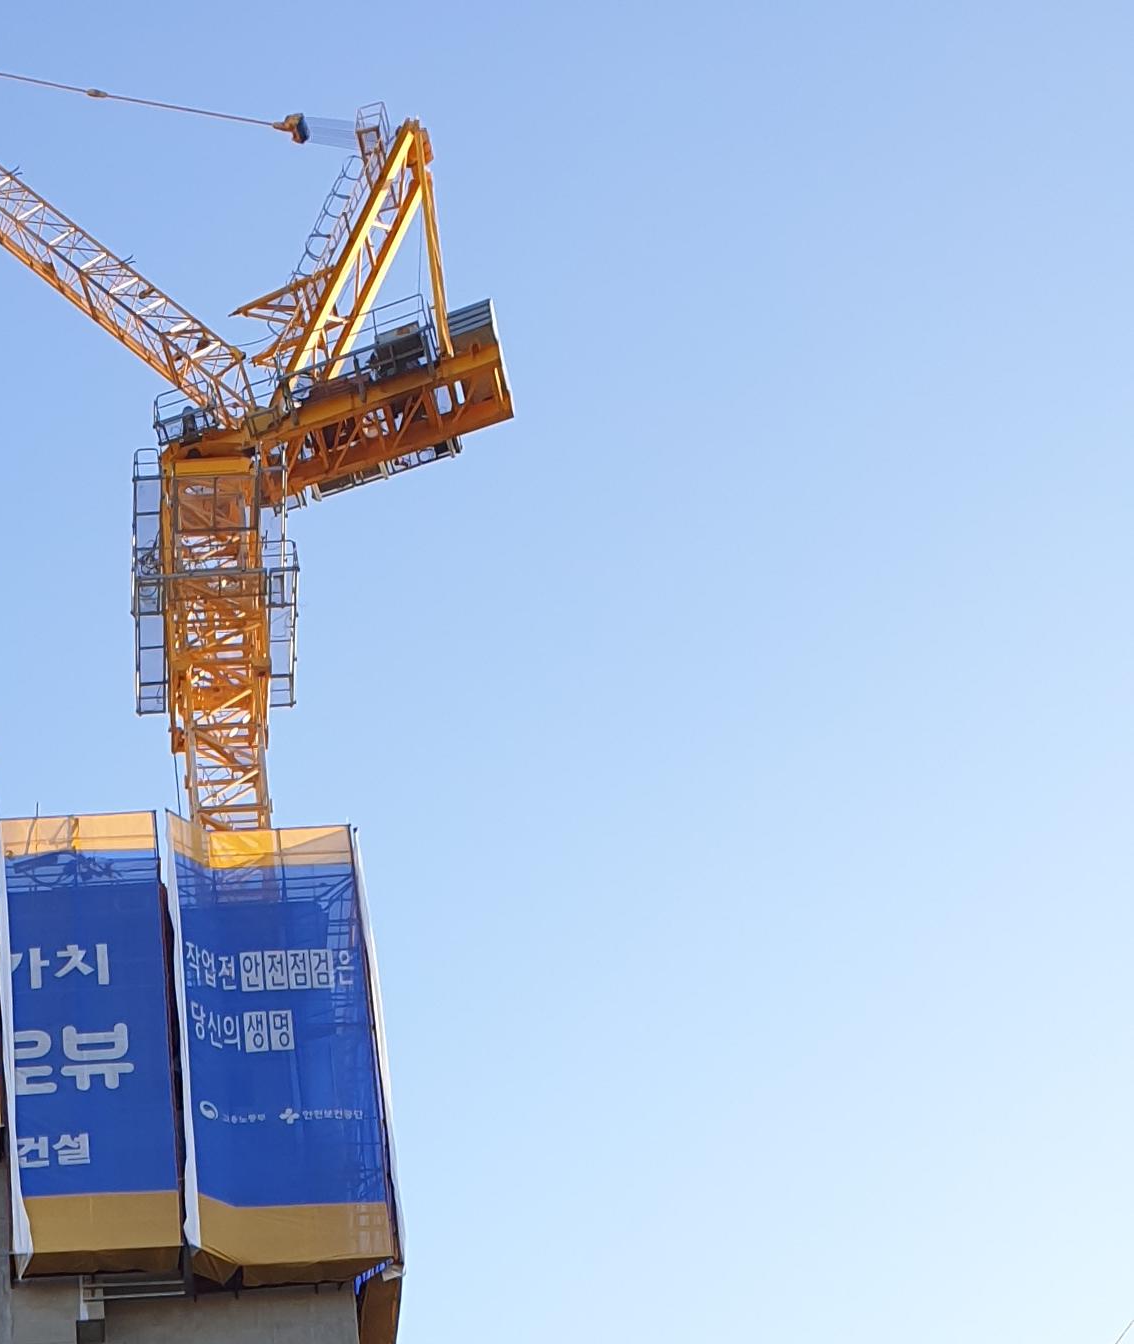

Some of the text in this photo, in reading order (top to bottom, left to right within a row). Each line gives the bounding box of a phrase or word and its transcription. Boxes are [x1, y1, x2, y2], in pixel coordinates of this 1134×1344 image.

[185, 941, 237, 991] 작업전
[190, 1001, 295, 1053] 당신의 생명
